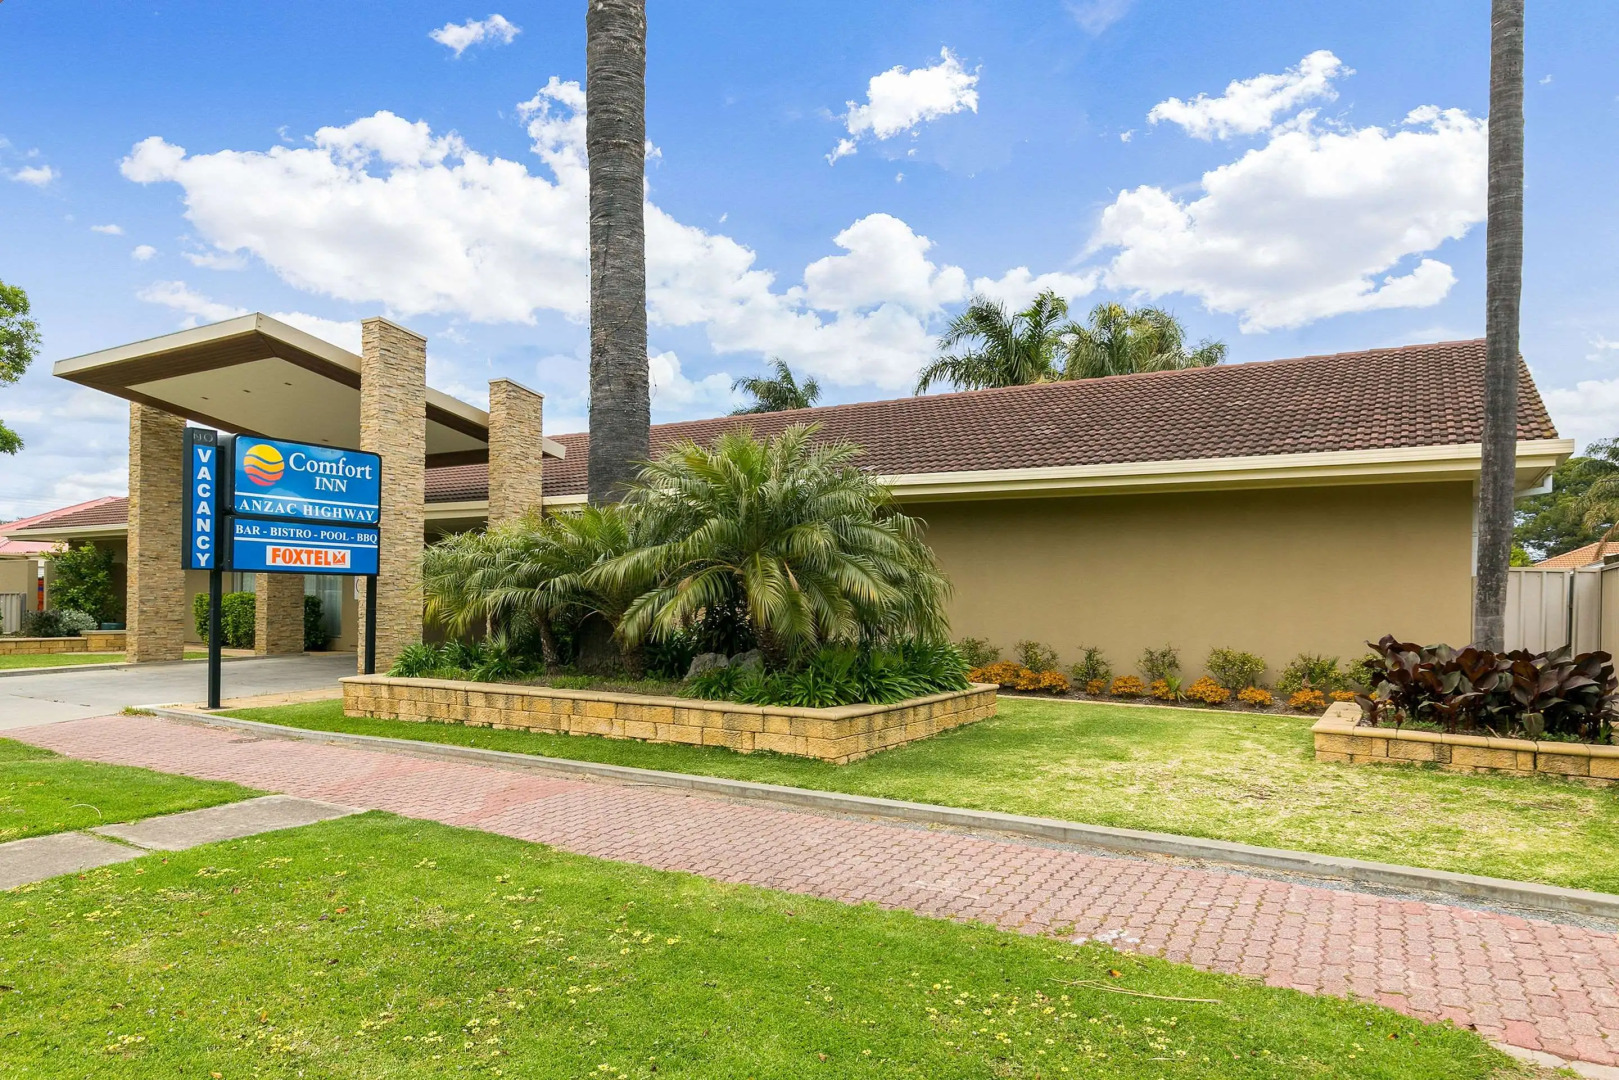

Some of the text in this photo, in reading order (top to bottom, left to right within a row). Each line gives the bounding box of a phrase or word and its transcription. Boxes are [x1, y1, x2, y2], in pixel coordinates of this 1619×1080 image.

[193, 432, 213, 443] NO
[289, 452, 373, 480] Comfort
[314, 477, 348, 493] INN
[196, 448, 212, 567] VACANCY
[239, 499, 375, 521] ANZAC HIGHWAY
[236, 525, 260, 535] BAR
[270, 527, 312, 539] BISTRO
[320, 530, 348, 541] POOL
[357, 534, 377, 545] BBQ
[271, 547, 331, 566] FOXTEL
